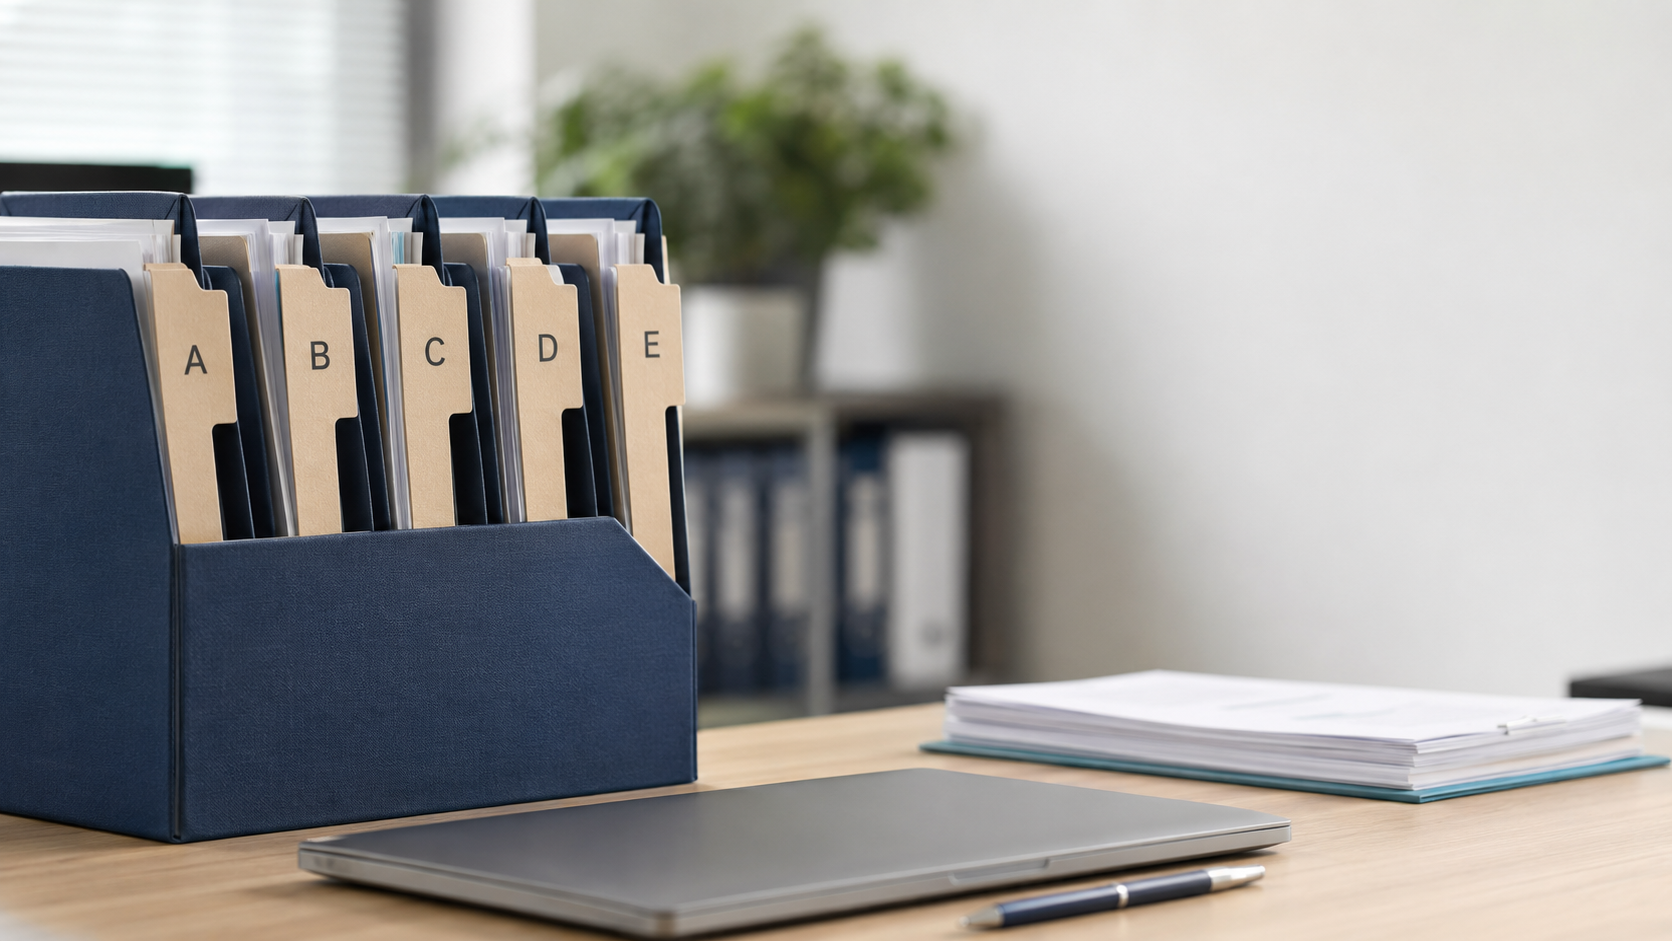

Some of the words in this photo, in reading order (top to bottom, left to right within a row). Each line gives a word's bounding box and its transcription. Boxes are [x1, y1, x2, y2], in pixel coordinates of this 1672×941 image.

[310, 340, 331, 371] B
[424, 336, 446, 367] C
[538, 333, 558, 363] D
[644, 330, 660, 358] E
[184, 344, 208, 376] A
